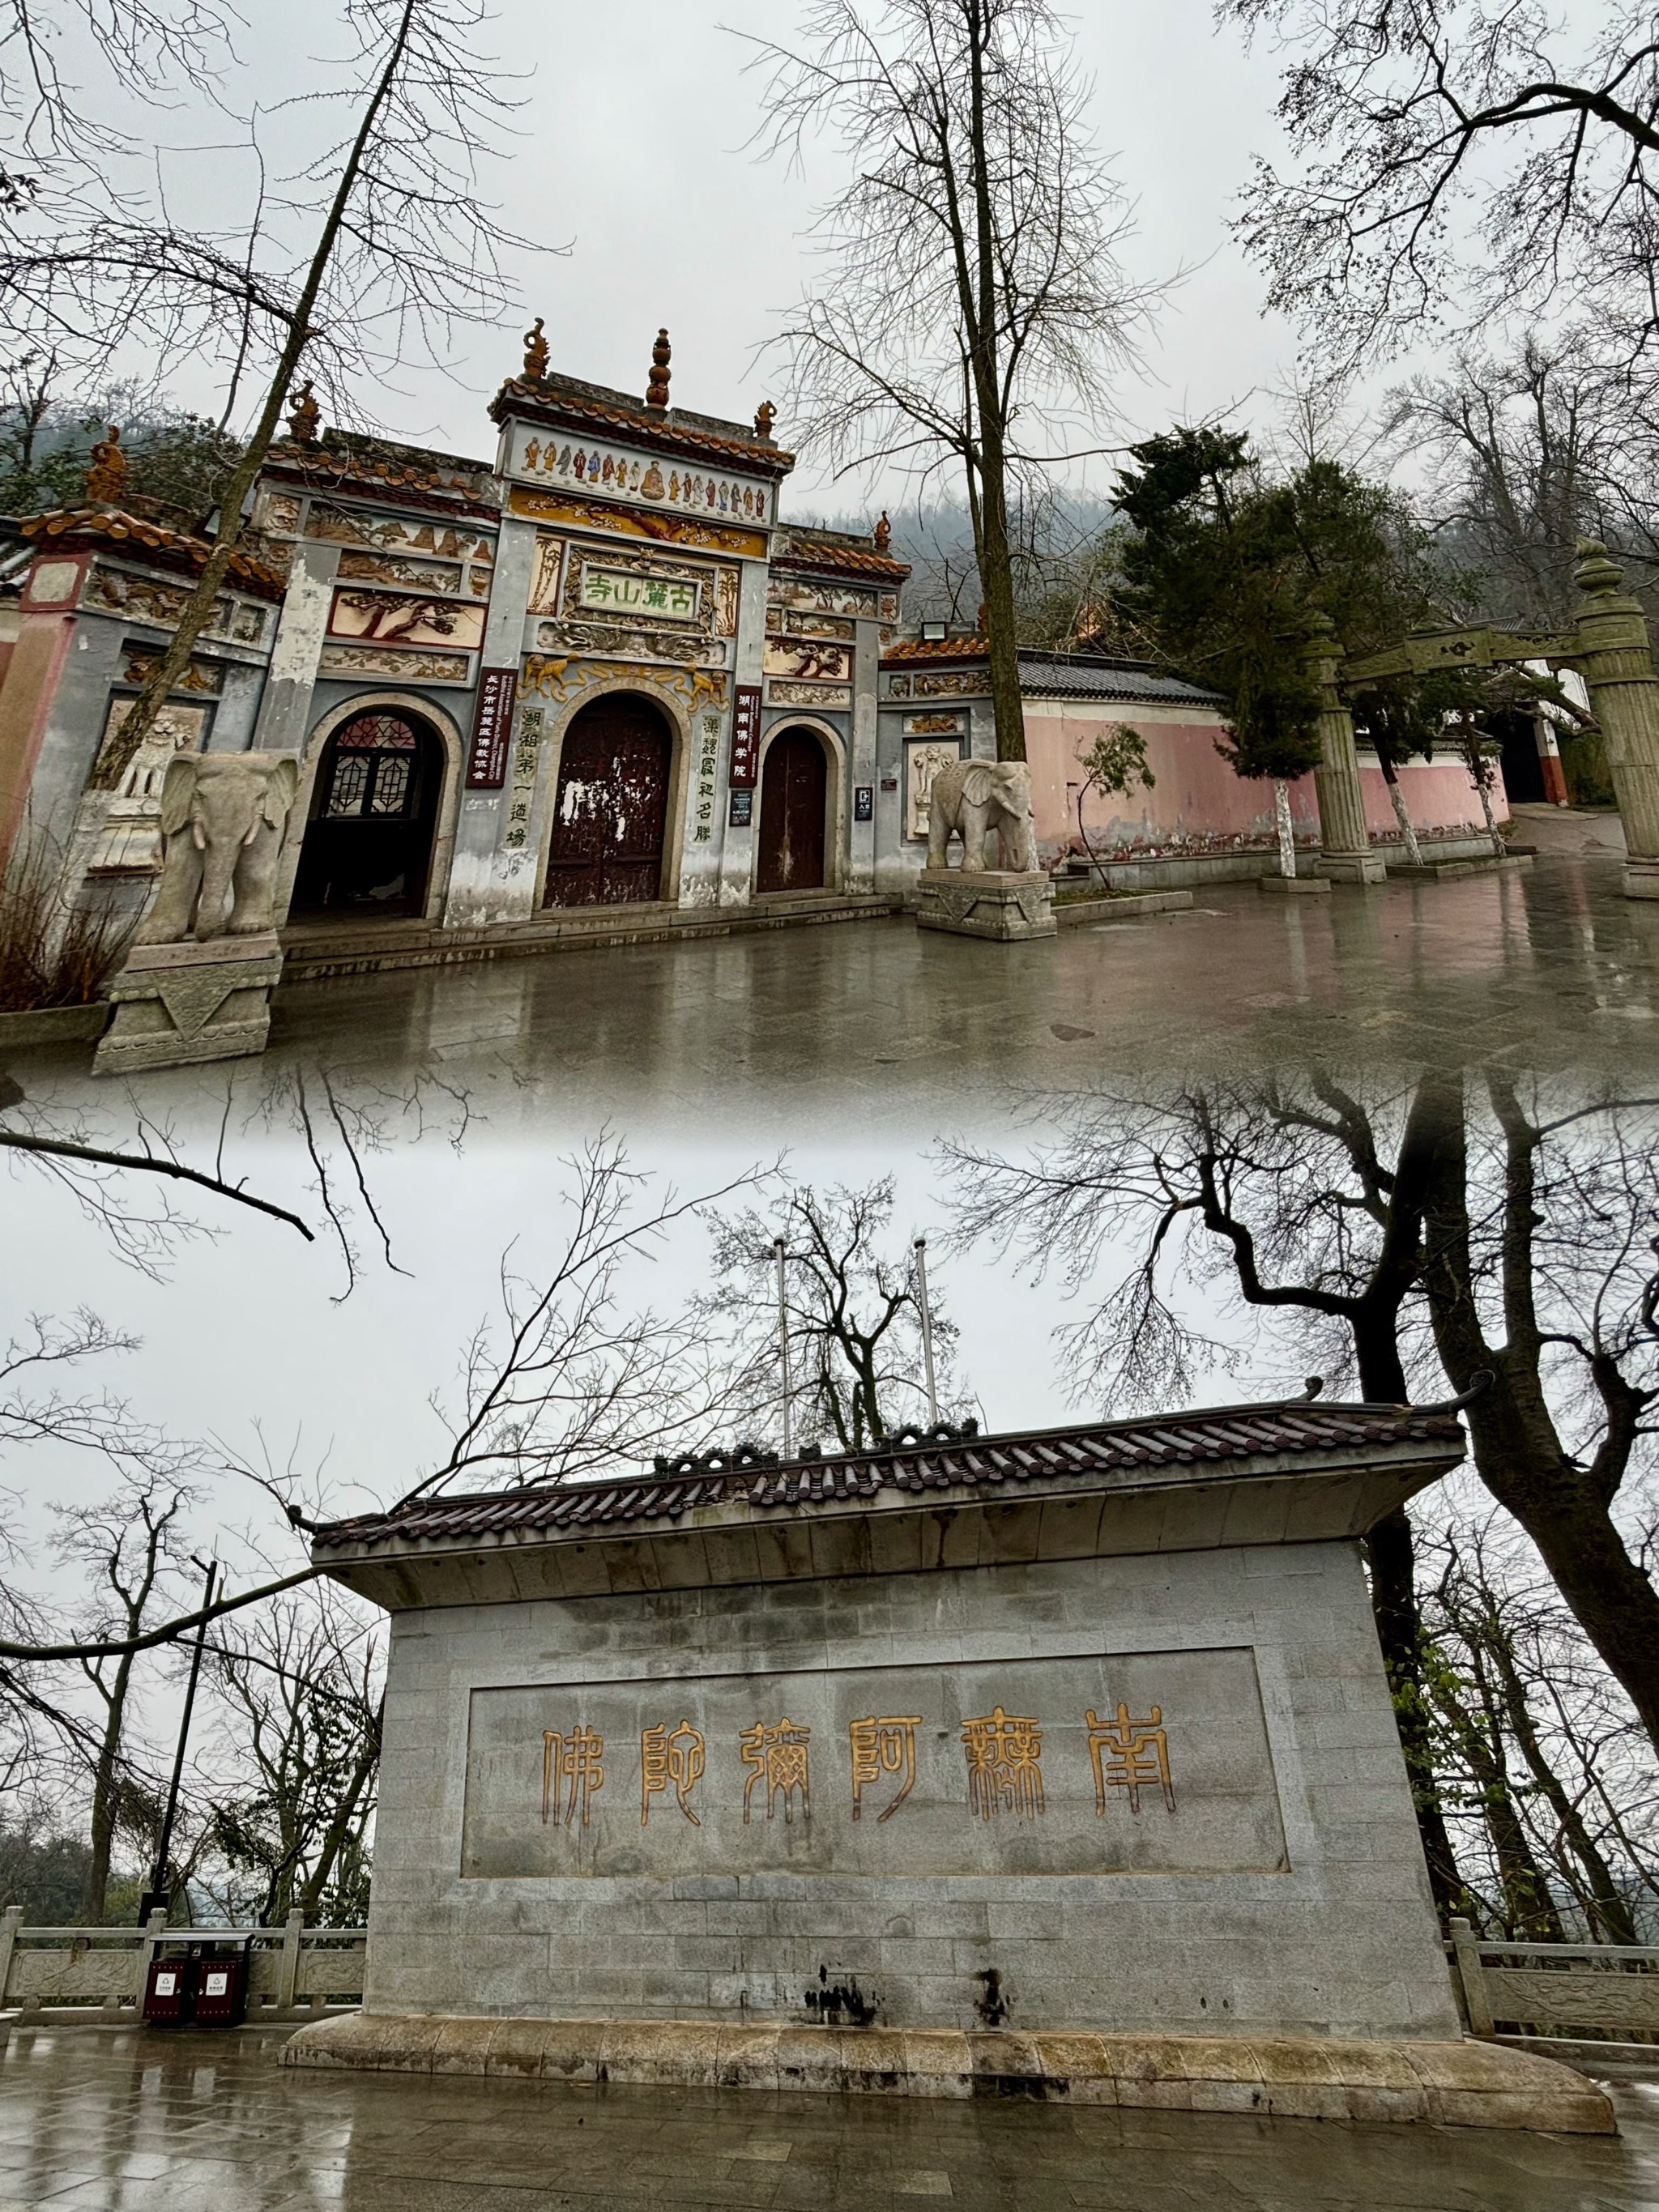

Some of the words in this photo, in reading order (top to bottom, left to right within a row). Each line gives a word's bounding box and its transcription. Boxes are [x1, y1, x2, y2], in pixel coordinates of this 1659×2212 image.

[497, 693, 505, 716] Association
[734, 695, 750, 777] 湖南佛学院
[488, 770, 496, 780] City
